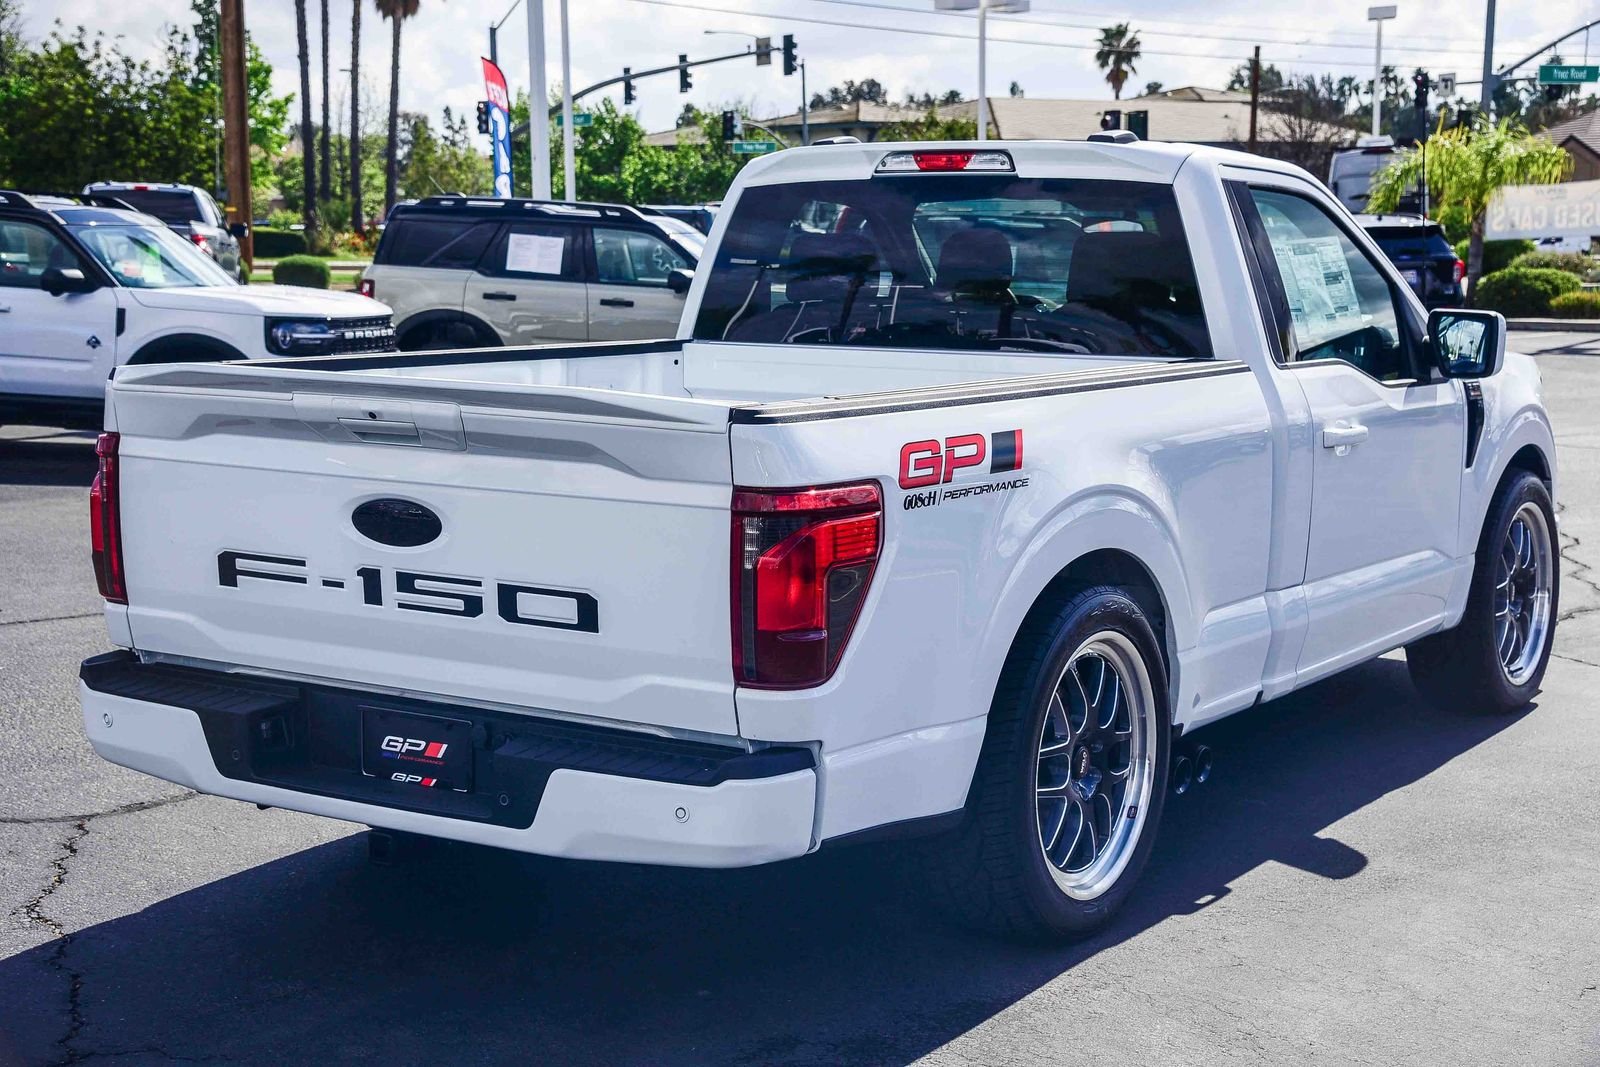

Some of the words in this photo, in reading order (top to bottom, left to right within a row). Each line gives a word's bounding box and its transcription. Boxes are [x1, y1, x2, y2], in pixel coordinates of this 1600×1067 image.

[344, 328, 394, 339] BRONCO
[898, 433, 986, 490] GP
[943, 477, 1029, 501] PERFORMANCE
[217, 549, 600, 634] F-150
[381, 735, 426, 754] GP
[391, 772, 422, 784] GP
